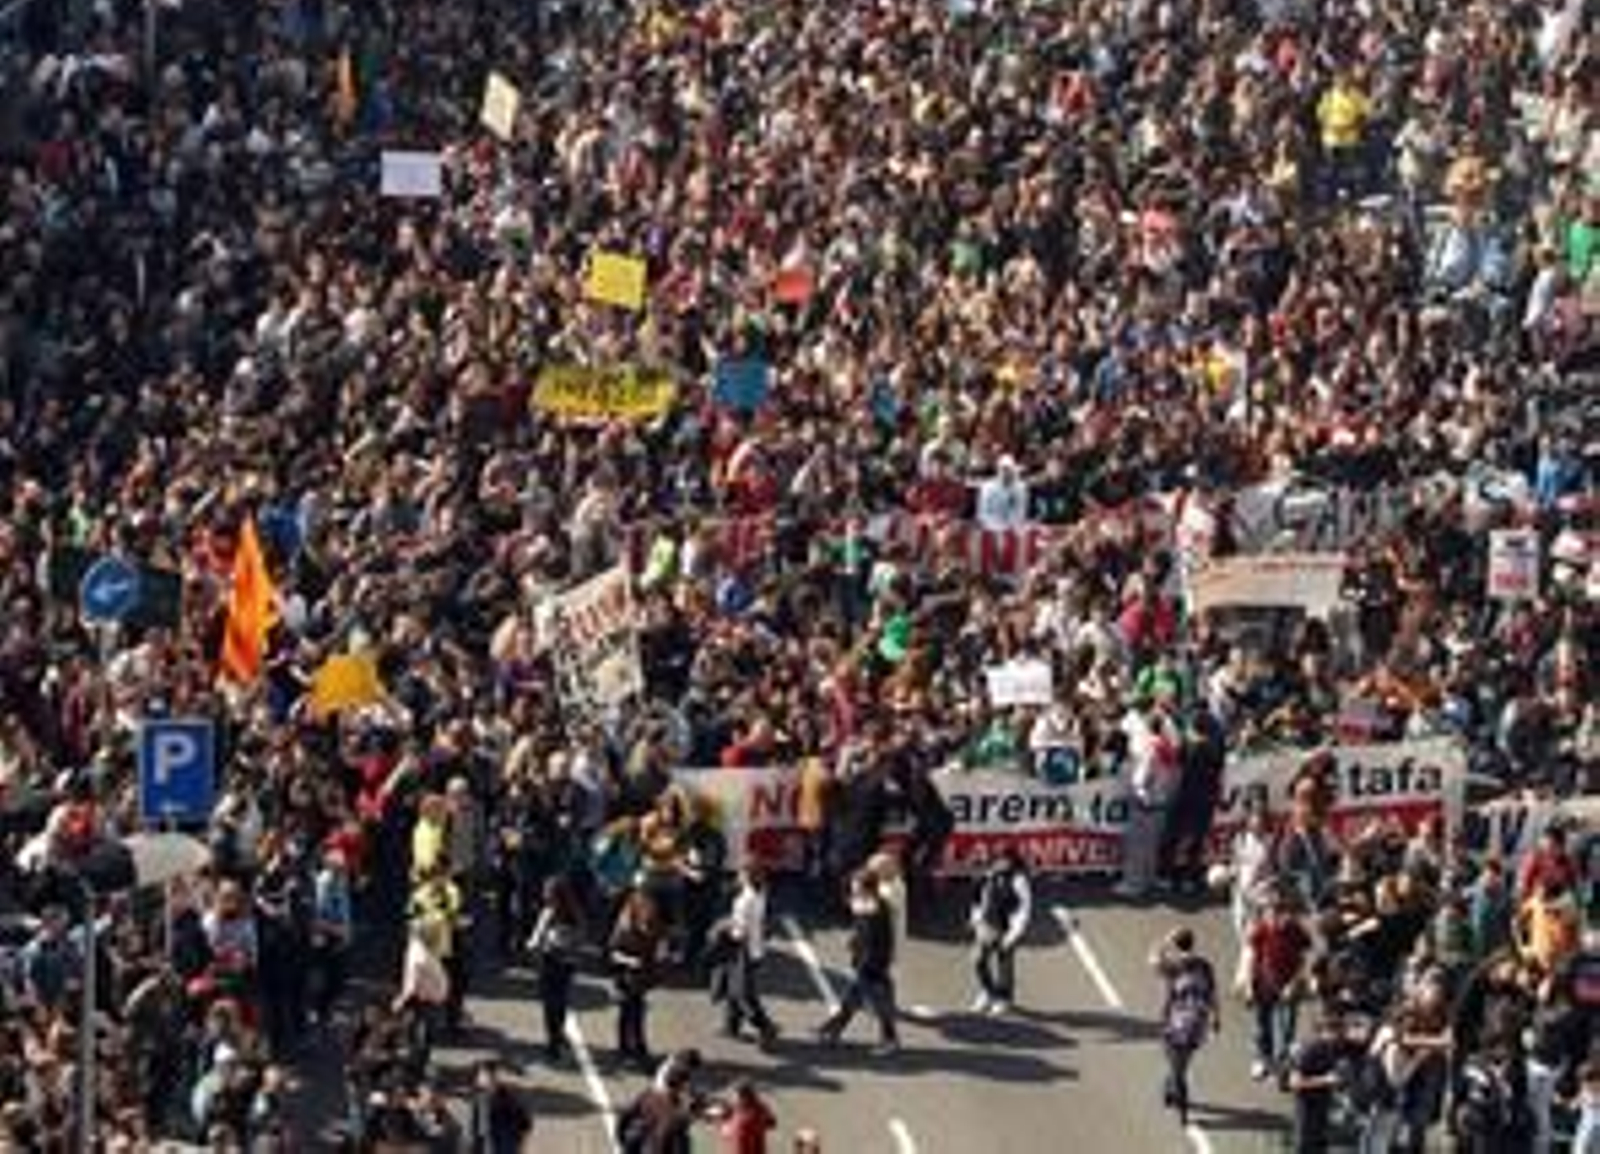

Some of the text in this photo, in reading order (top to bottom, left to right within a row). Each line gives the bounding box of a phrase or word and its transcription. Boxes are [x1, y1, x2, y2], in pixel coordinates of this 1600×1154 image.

[154, 732, 198, 784] P
[951, 793, 1075, 823] arem
[1347, 756, 1442, 798] tafa
